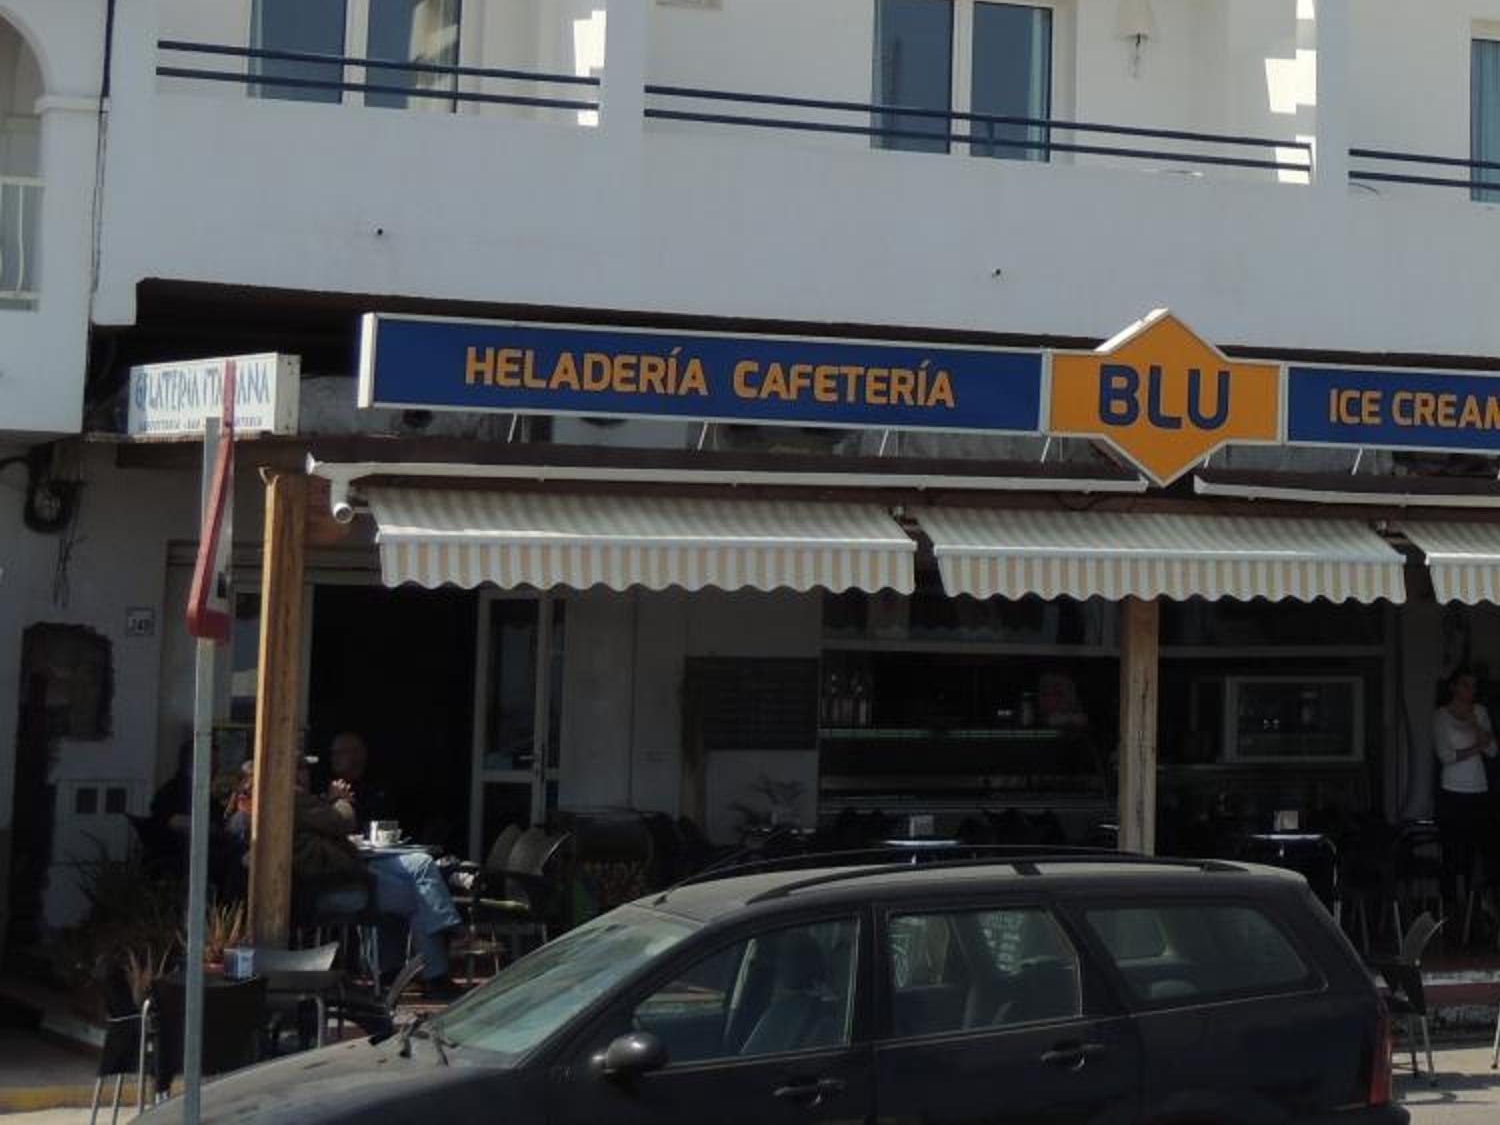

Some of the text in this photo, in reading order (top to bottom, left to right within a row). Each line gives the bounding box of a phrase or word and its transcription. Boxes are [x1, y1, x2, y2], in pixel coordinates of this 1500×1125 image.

[203, 362, 270, 407] ITAANA
[465, 346, 955, 408] HELADERÍA CAFETERÍA
[1100, 364, 1230, 431] BLU
[1328, 388, 1382, 426] ICE
